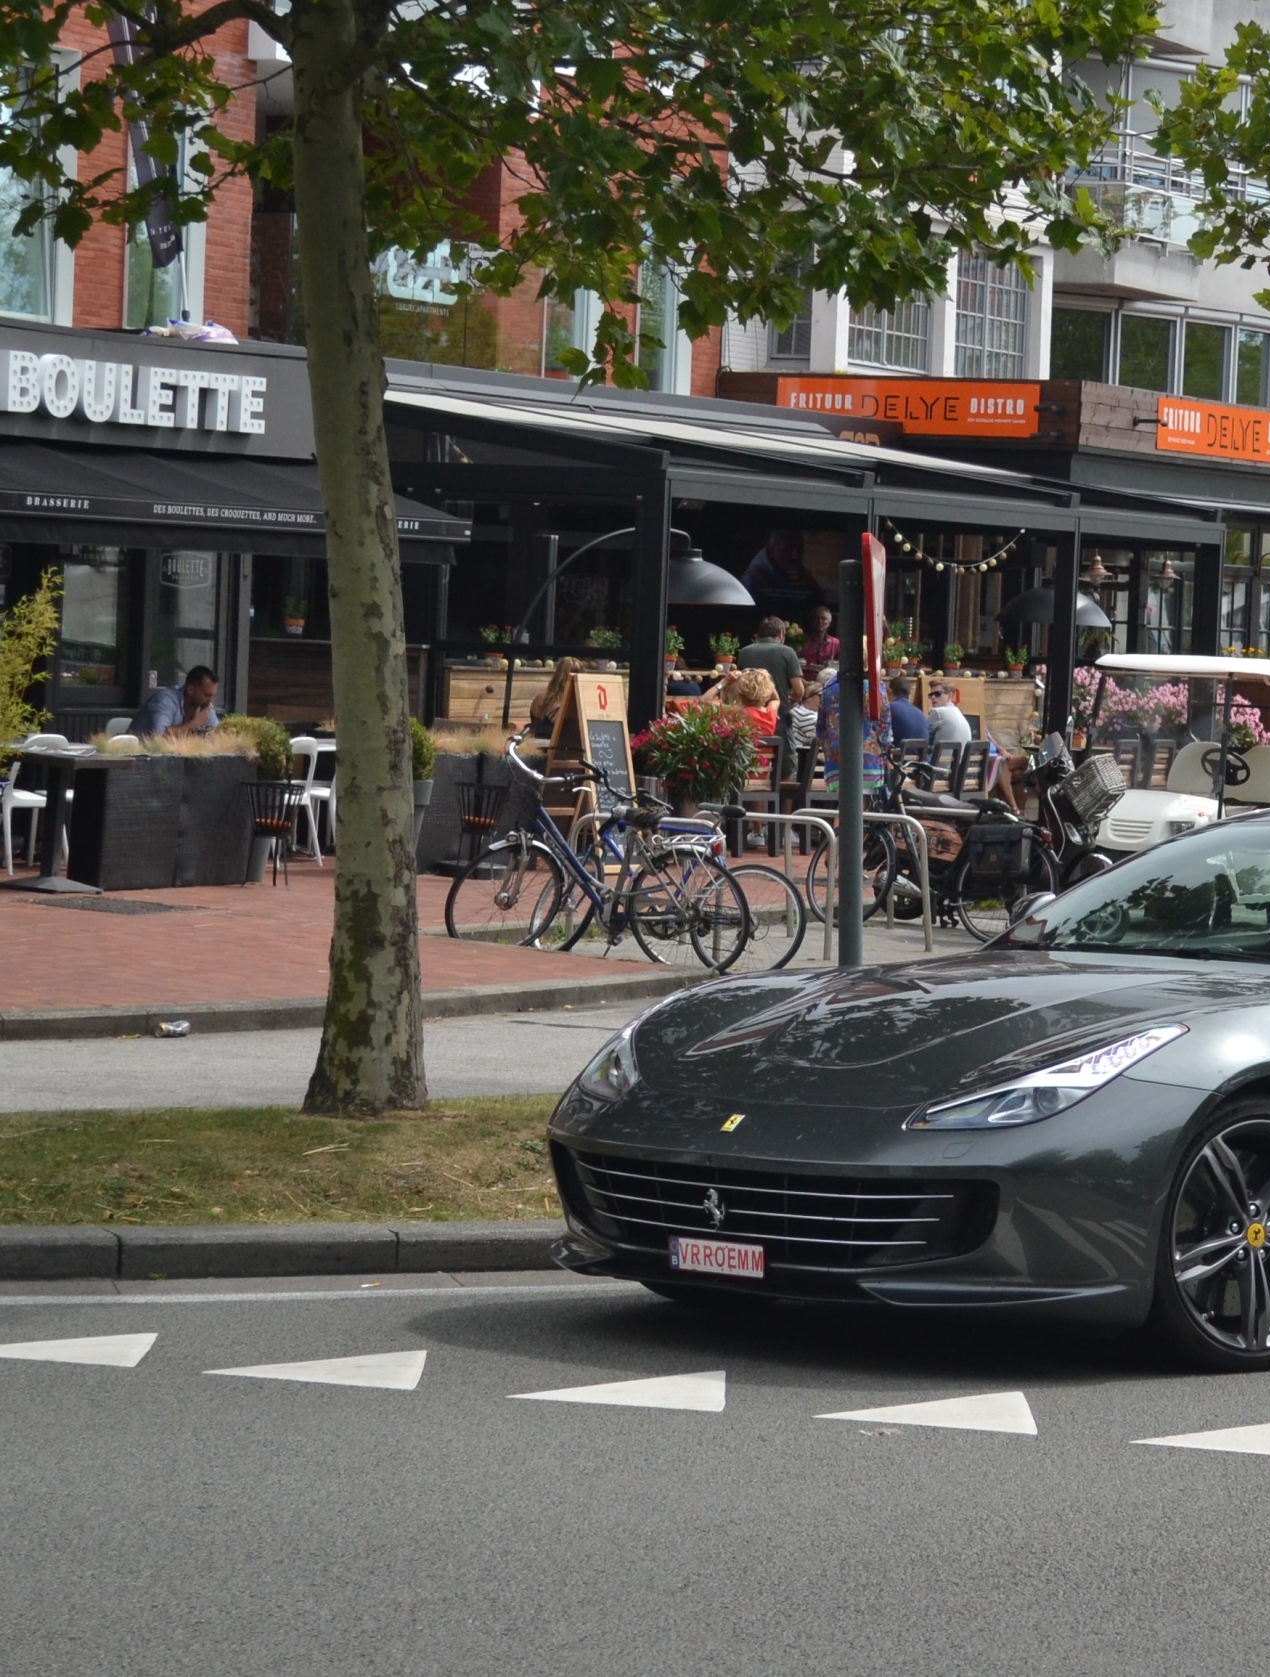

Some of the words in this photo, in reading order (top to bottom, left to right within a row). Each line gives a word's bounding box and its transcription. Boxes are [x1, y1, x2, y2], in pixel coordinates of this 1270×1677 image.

[5, 350, 267, 434] BOULETTE
[790, 392, 853, 410] FRITUUR
[861, 394, 960, 421] DELYE
[969, 397, 1025, 415] BISTRO
[1163, 407, 1201, 433] FRITUUR
[1207, 413, 1262, 453] DELYE
[26, 496, 90, 509] BRASSERIE
[153, 504, 166, 514] DES
[167, 505, 206, 517] BOULETTES,
[207, 507, 219, 517] DES
[220, 508, 262, 521] CROQUETTES,
[263, 511, 276, 521] AND
[277, 513, 295, 522] MUCH
[168, 558, 204, 577] BOULETTE
[671, 1255, 678, 1265] B
[679, 1242, 763, 1272] VRROEMM
